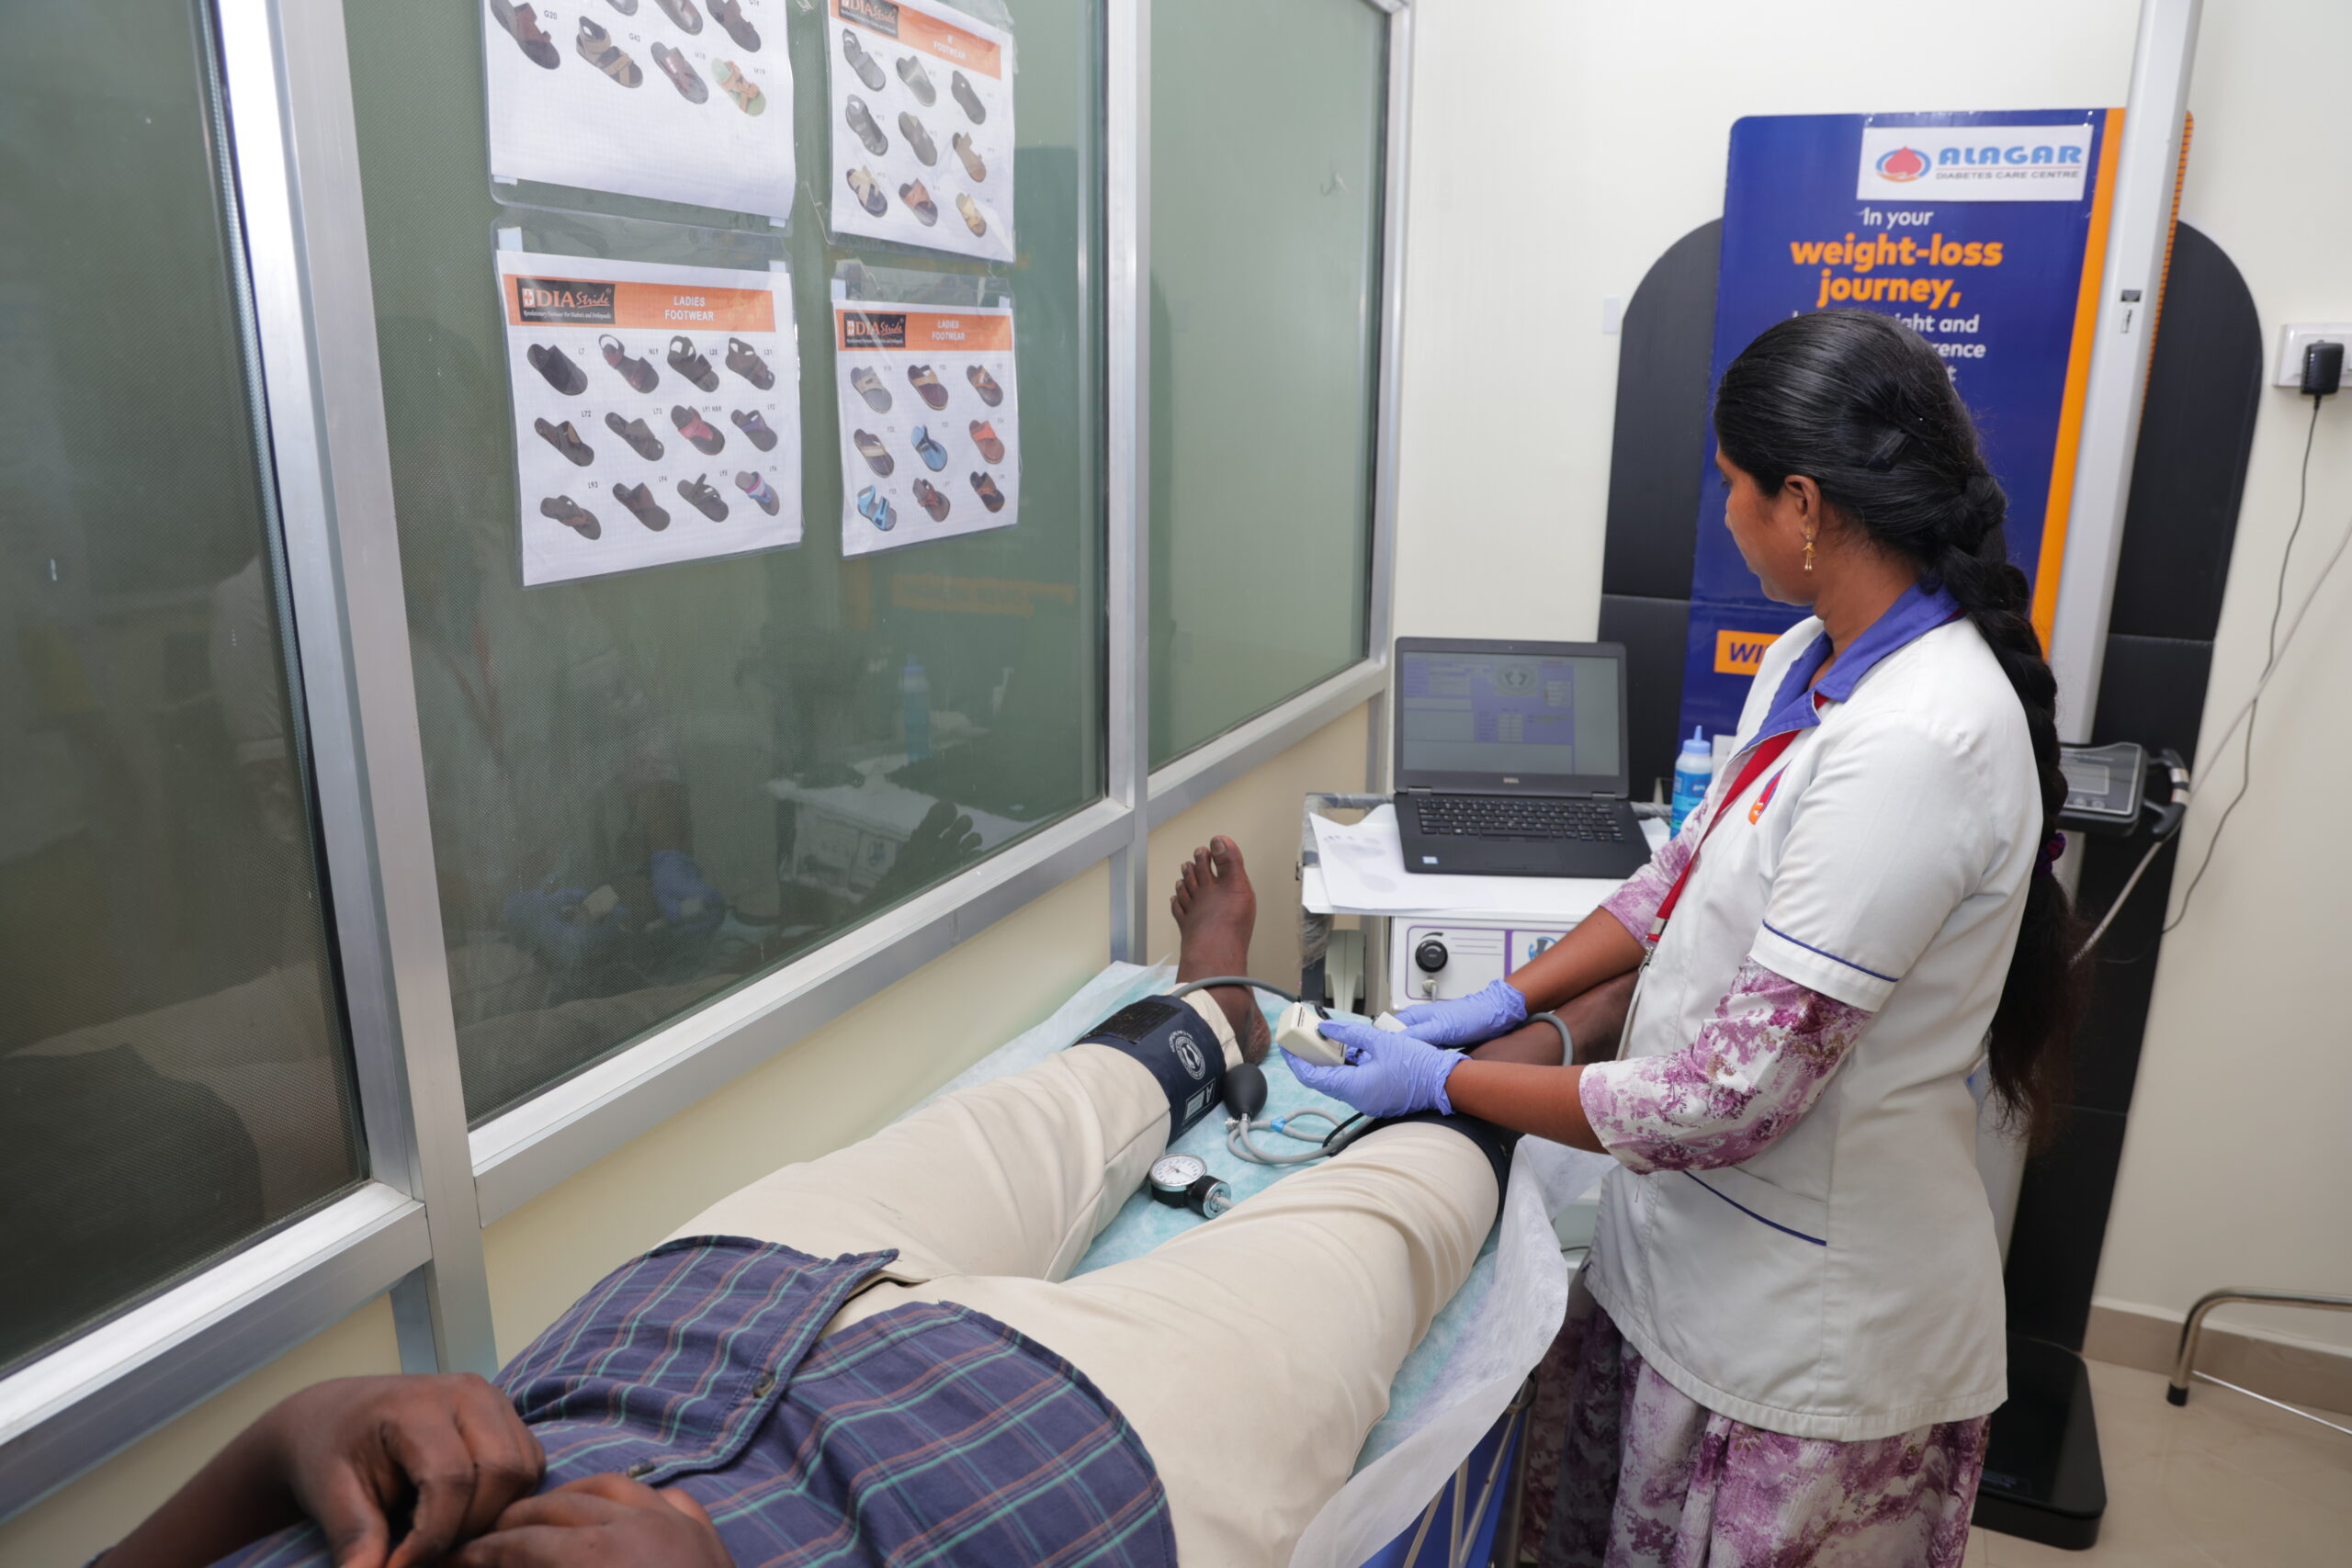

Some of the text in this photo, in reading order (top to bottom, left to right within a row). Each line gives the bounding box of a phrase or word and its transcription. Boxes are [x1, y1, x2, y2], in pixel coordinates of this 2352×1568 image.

[543, 9, 558, 20] G20
[1939, 145, 2083, 165] ALAGAR
[1936, 172, 1992, 180] DIABETES
[2030, 171, 2080, 179] CENTRE
[1862, 207, 1934, 230] In your
[1791, 232, 2004, 273] weight-loss
[1816, 268, 1962, 310] journey,
[537, 290, 610, 308] DIA Stride
[673, 295, 706, 307] LADIES
[664, 309, 714, 321] FOOTWEAR
[937, 320, 959, 329] LADIES
[1939, 314, 1980, 333] and
[932, 332, 966, 341] FOOTWEAR
